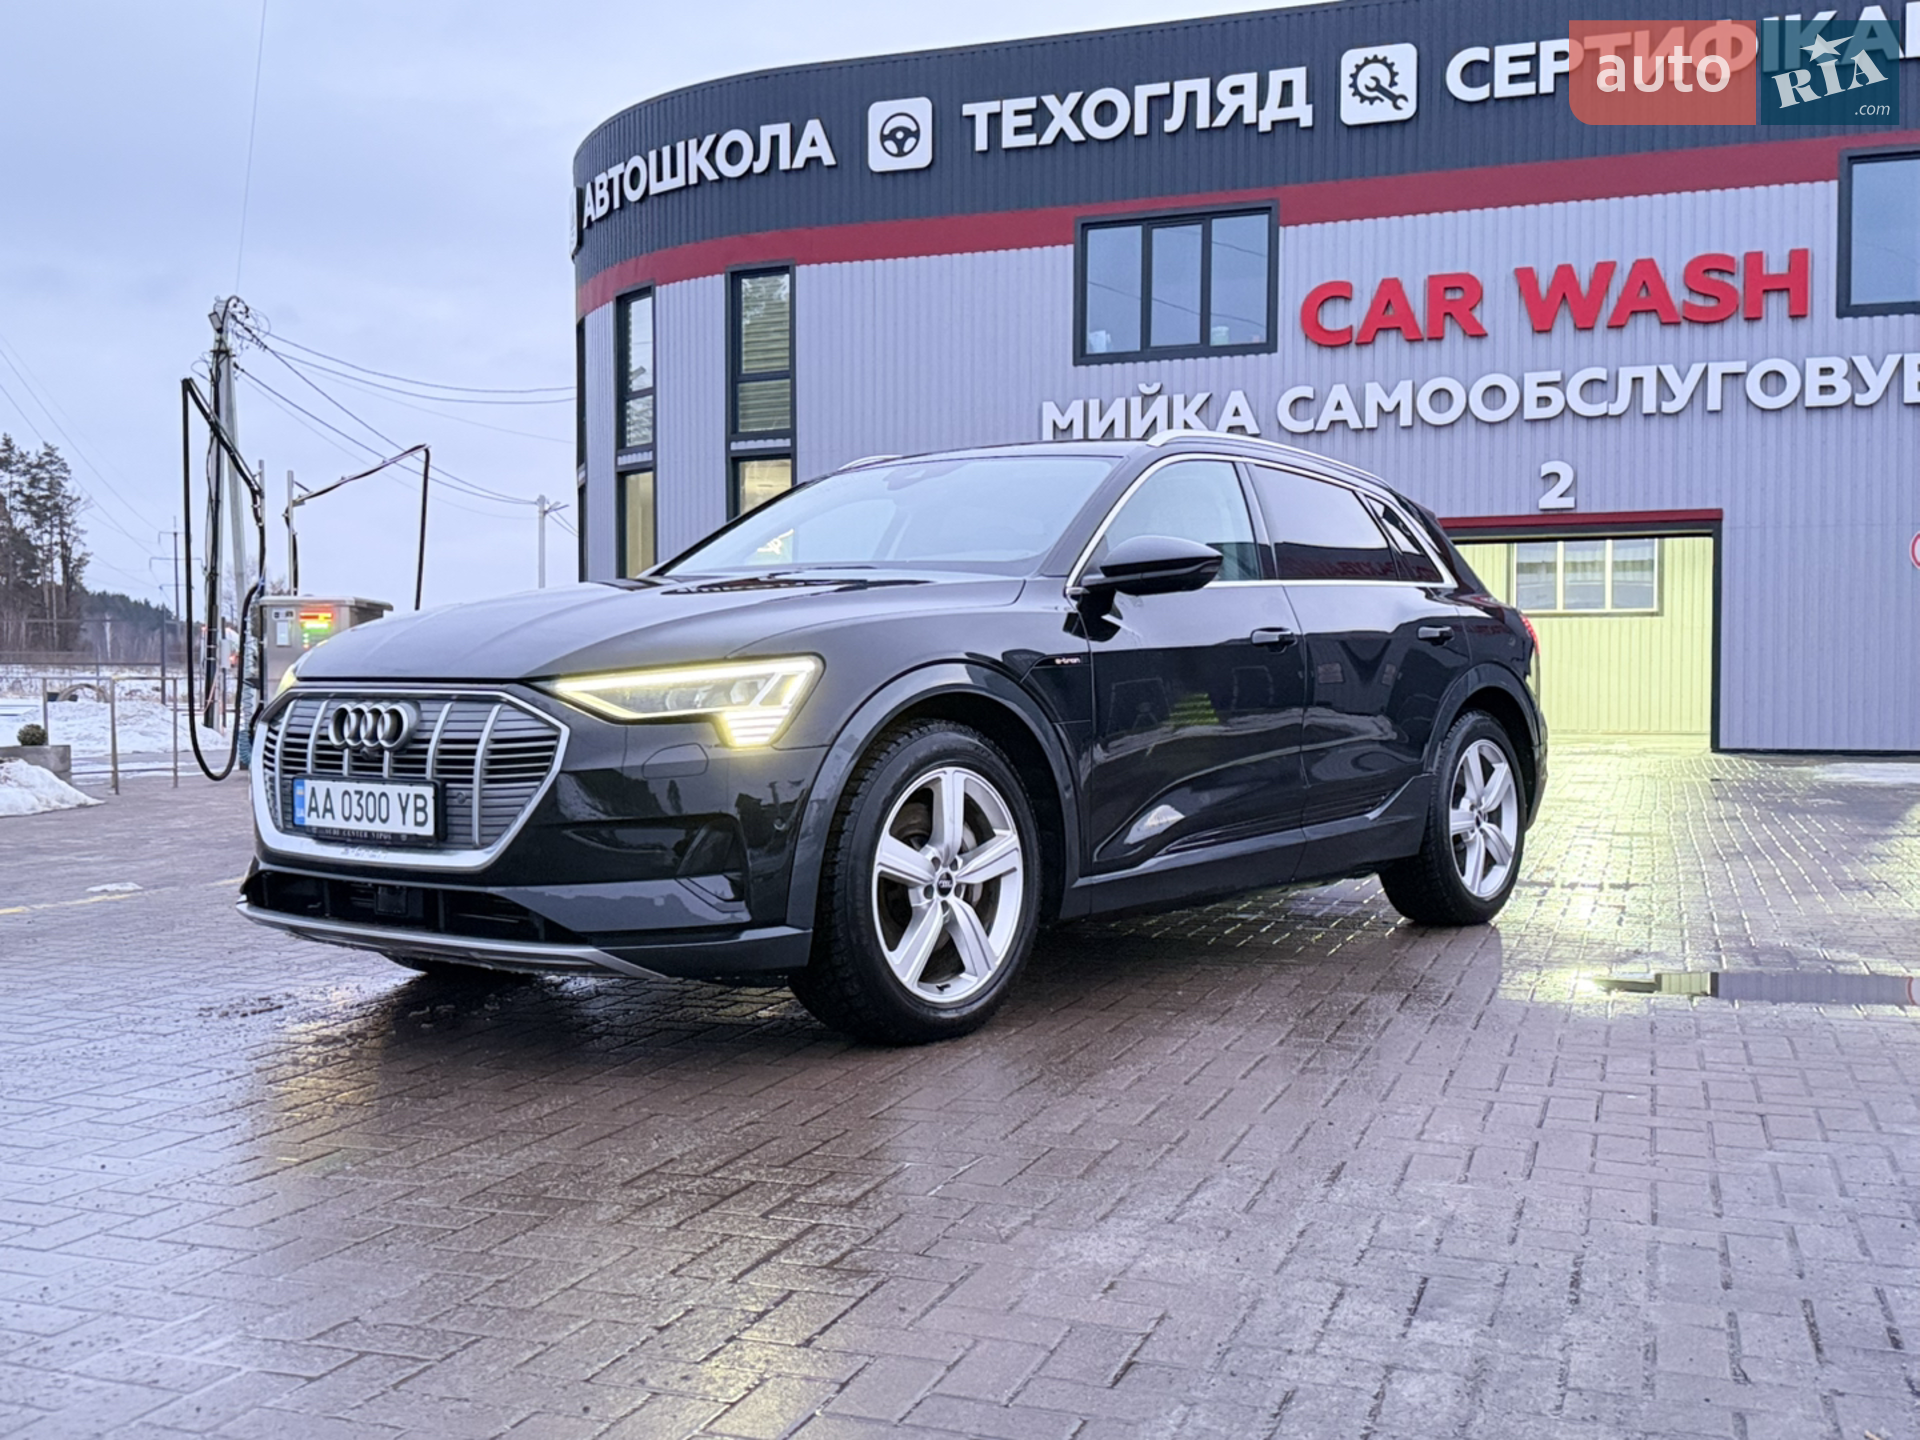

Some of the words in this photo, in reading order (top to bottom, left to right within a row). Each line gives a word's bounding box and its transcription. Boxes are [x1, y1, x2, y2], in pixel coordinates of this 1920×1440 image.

[962, 66, 1313, 152] ТЕХОГЛЯД
[583, 118, 837, 229] АВТОШКОЛА
[1301, 272, 1487, 347] CAR
[1514, 248, 1810, 333] WASH
[1042, 382, 1261, 441] МИЙКА
[1538, 460, 1576, 509] 2
[307, 786, 336, 820] AA
[341, 789, 390, 824] 0300
[397, 793, 429, 827] YB
